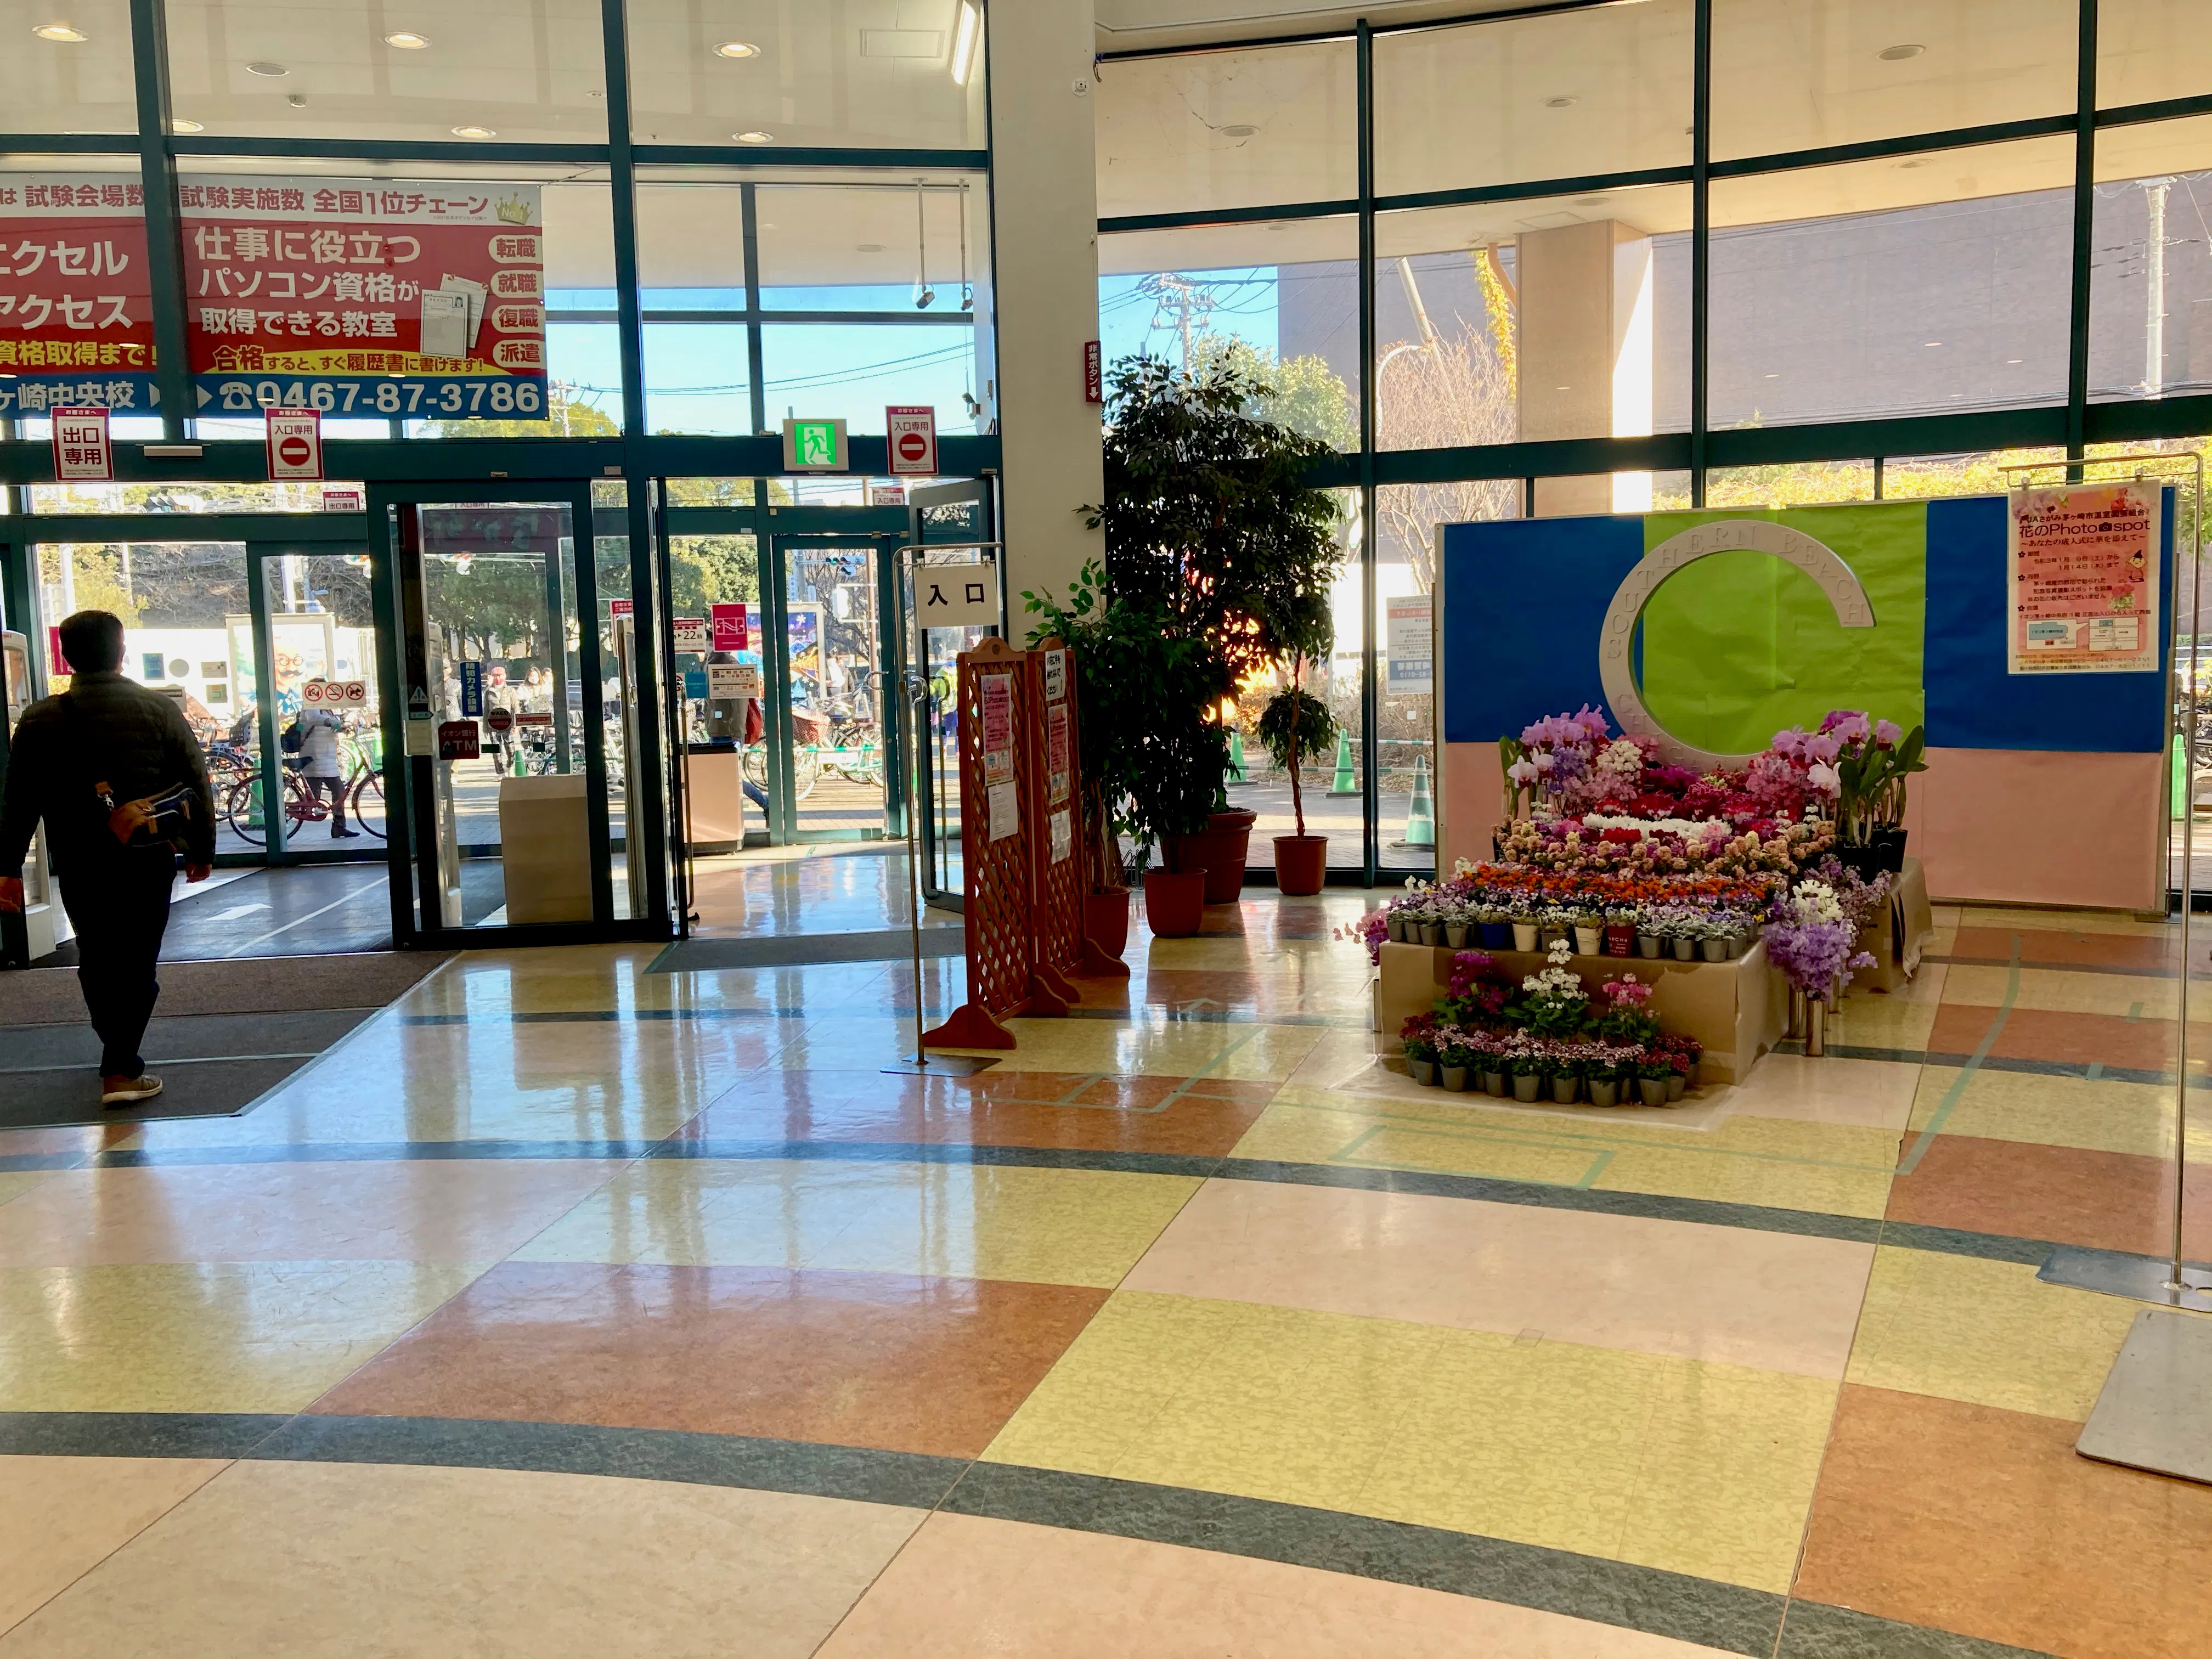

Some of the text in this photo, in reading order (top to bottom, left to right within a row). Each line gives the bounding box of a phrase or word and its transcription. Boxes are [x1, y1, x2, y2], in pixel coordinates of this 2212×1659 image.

[25, 184, 144, 207] 試験会場数
[180, 185, 489, 215] 試験実施数 全国1位チェーン
[194, 225, 421, 264] 仕事に役立つ
[496, 238, 535, 258] 転職
[199, 267, 419, 302] パソコン資格が
[498, 273, 537, 292] 就職
[200, 307, 398, 337] 取得できる教室
[499, 308, 539, 328] 復職
[500, 343, 540, 363] 派遣
[256, 381, 540, 413] 0467-87-3786
[63, 427, 99, 443] 出口
[275, 425, 313, 435] 入口専用
[895, 422, 928, 431] 入口専用
[64, 448, 101, 465] 専用
[2114, 519, 2151, 532] spot
[928, 583, 985, 607] 入口
